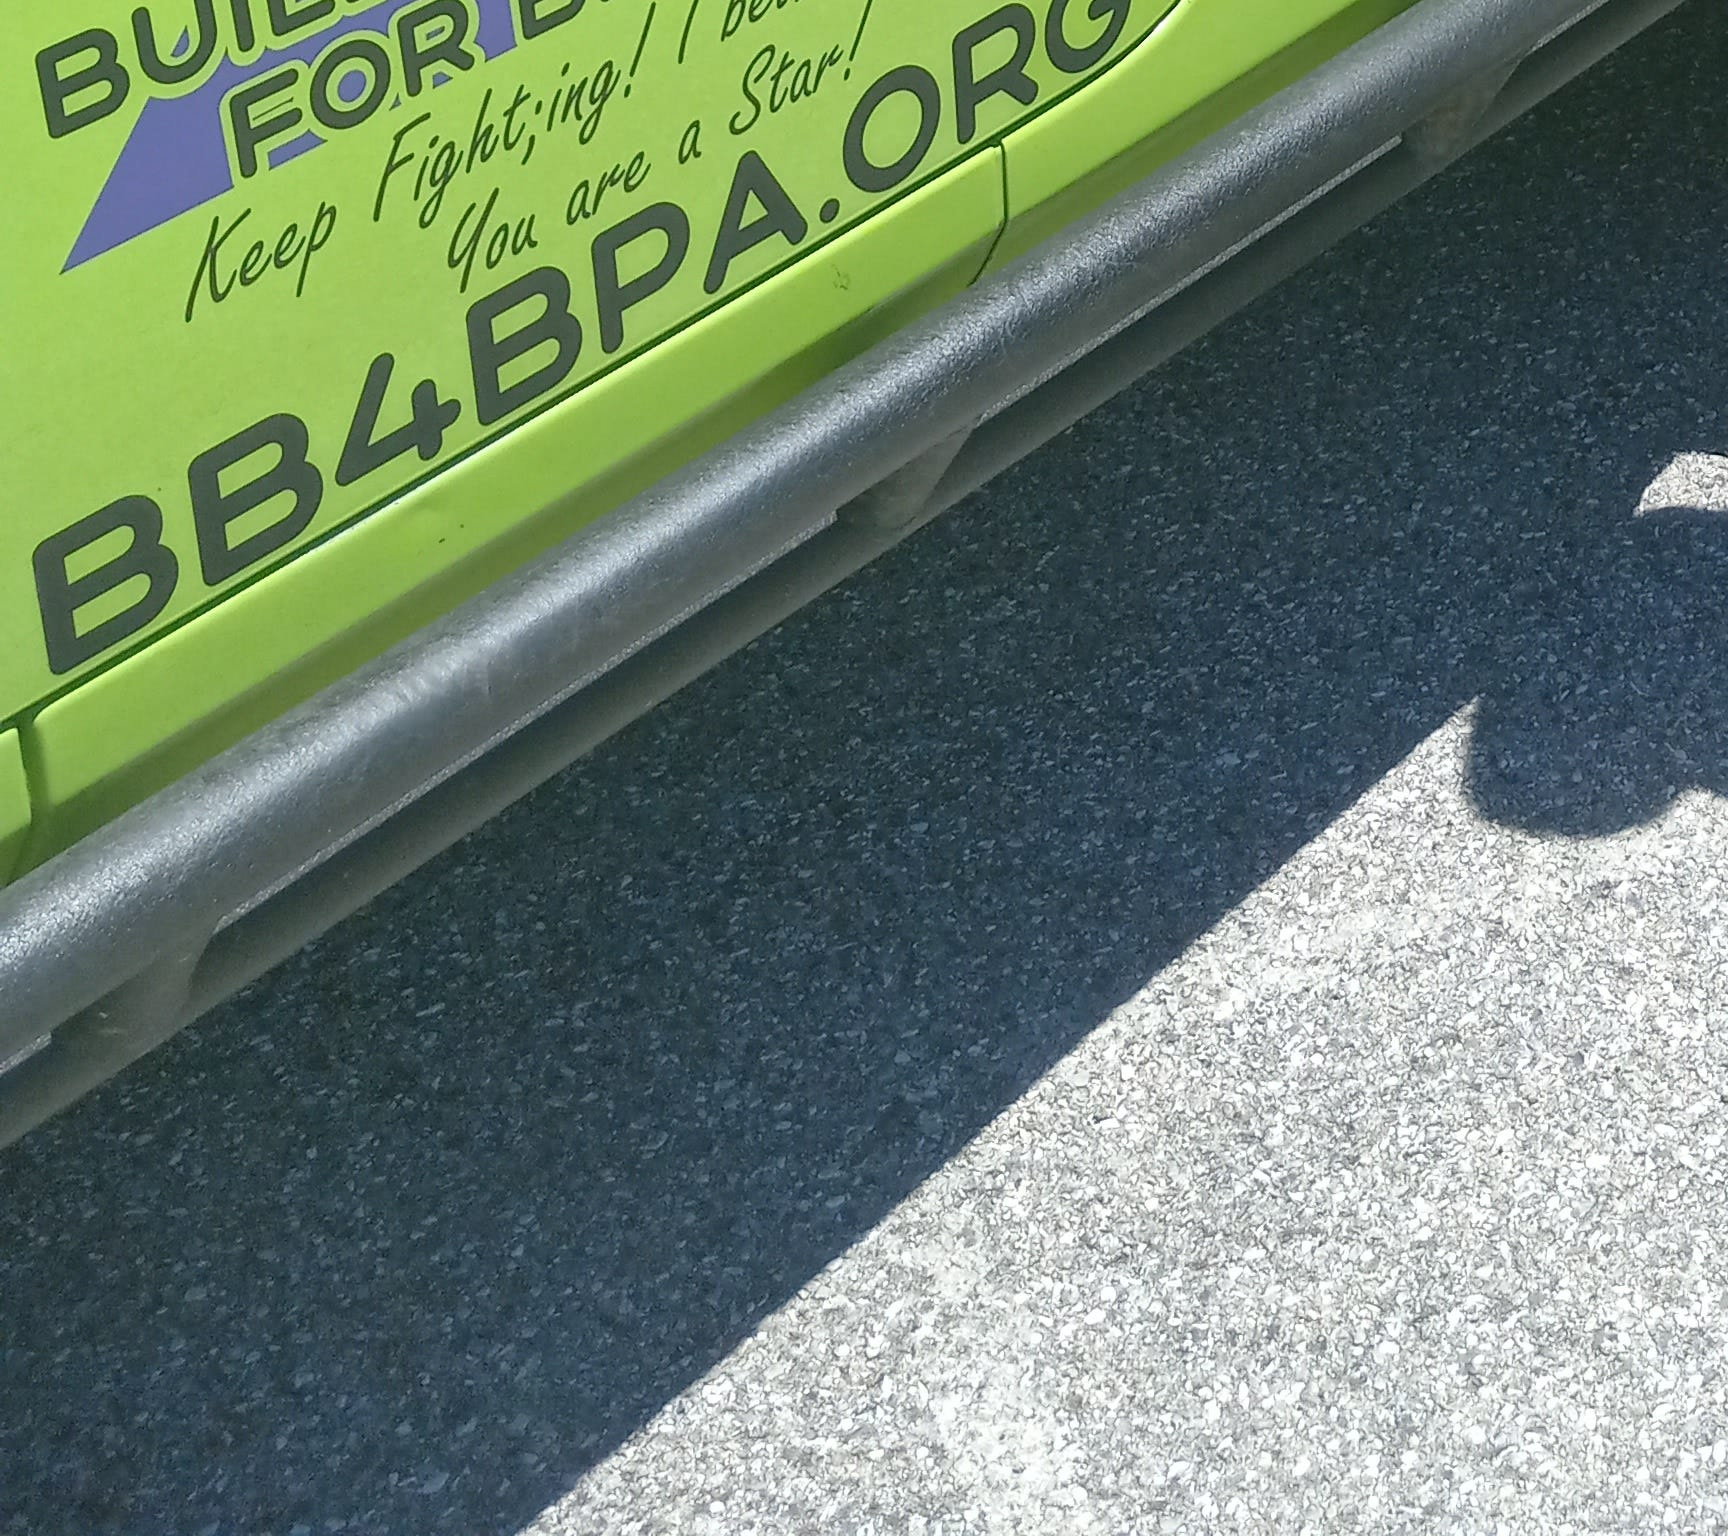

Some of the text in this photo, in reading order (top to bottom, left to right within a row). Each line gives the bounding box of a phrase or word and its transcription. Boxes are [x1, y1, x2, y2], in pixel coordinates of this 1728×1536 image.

[228, 0, 474, 177] FOR
[186, 202, 336, 322] Keep
[446, 189, 537, 293] You
[567, 152, 650, 225] are
[679, 122, 701, 164] a
